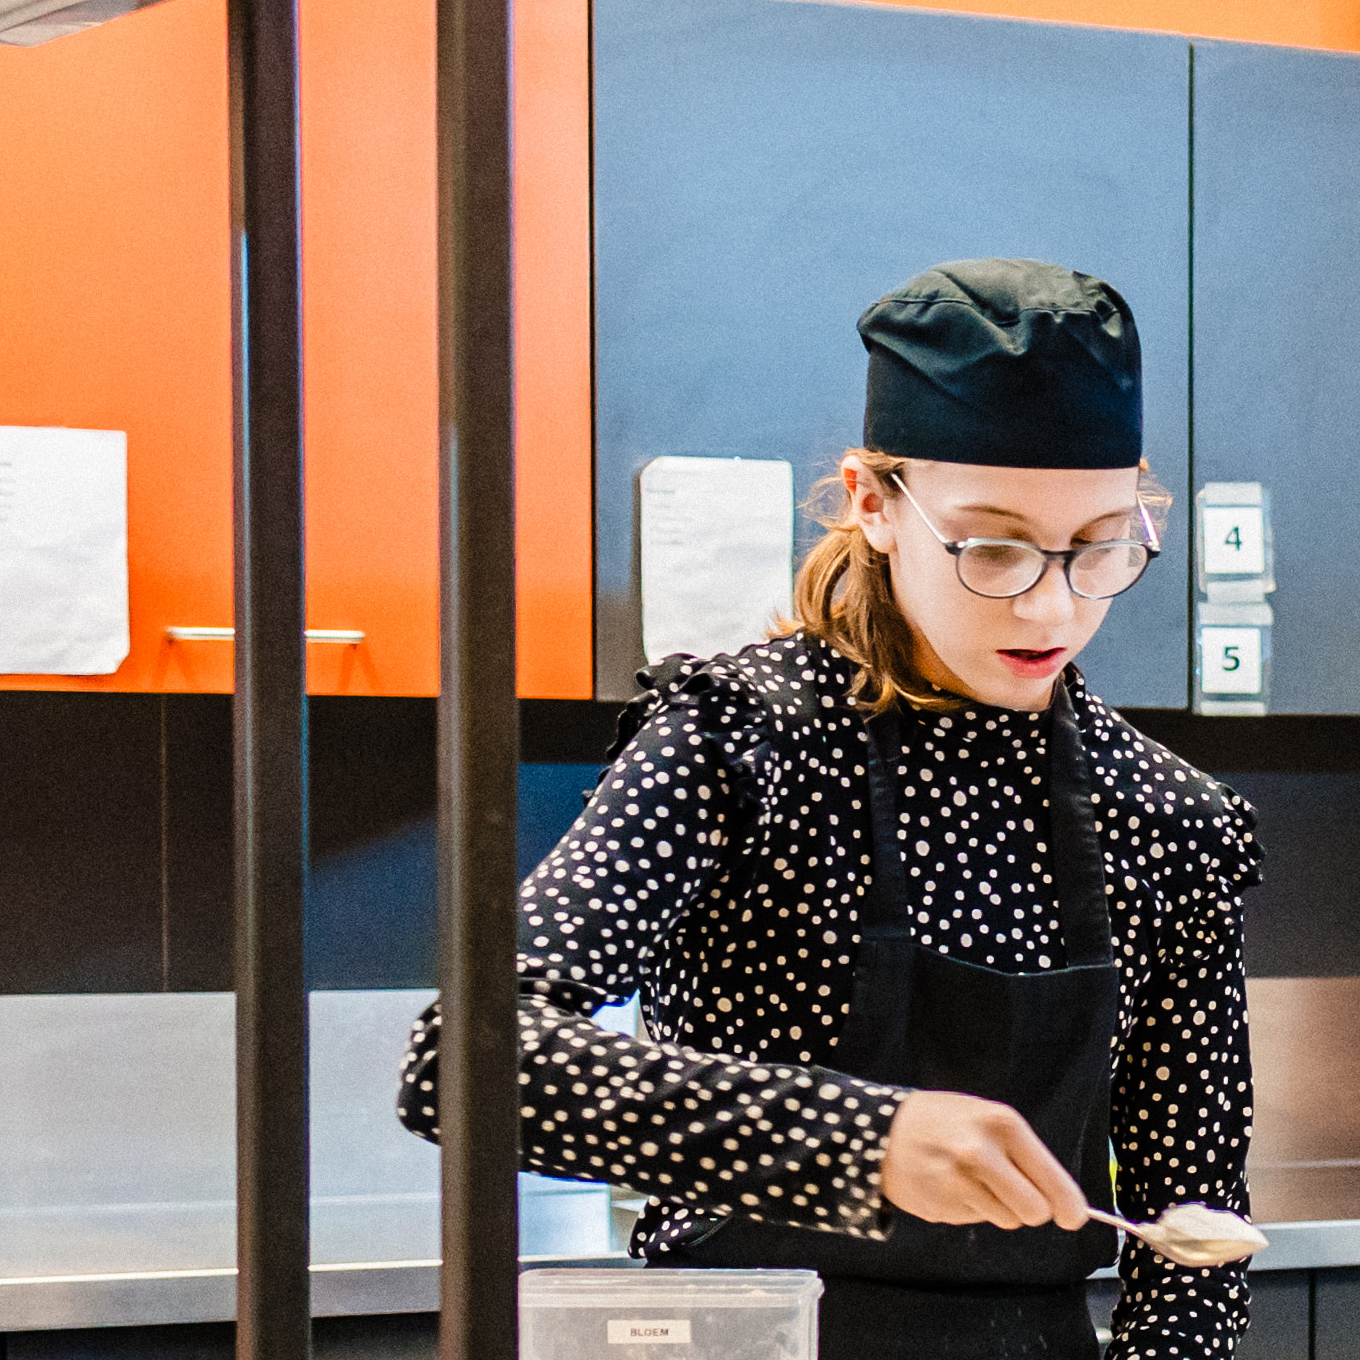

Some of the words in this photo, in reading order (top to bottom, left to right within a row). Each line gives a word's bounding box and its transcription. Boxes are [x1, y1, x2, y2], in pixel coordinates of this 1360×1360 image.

[1225, 526, 1242, 551] 4
[1223, 646, 1240, 671] 5
[630, 1328, 669, 1337] BLOEM
